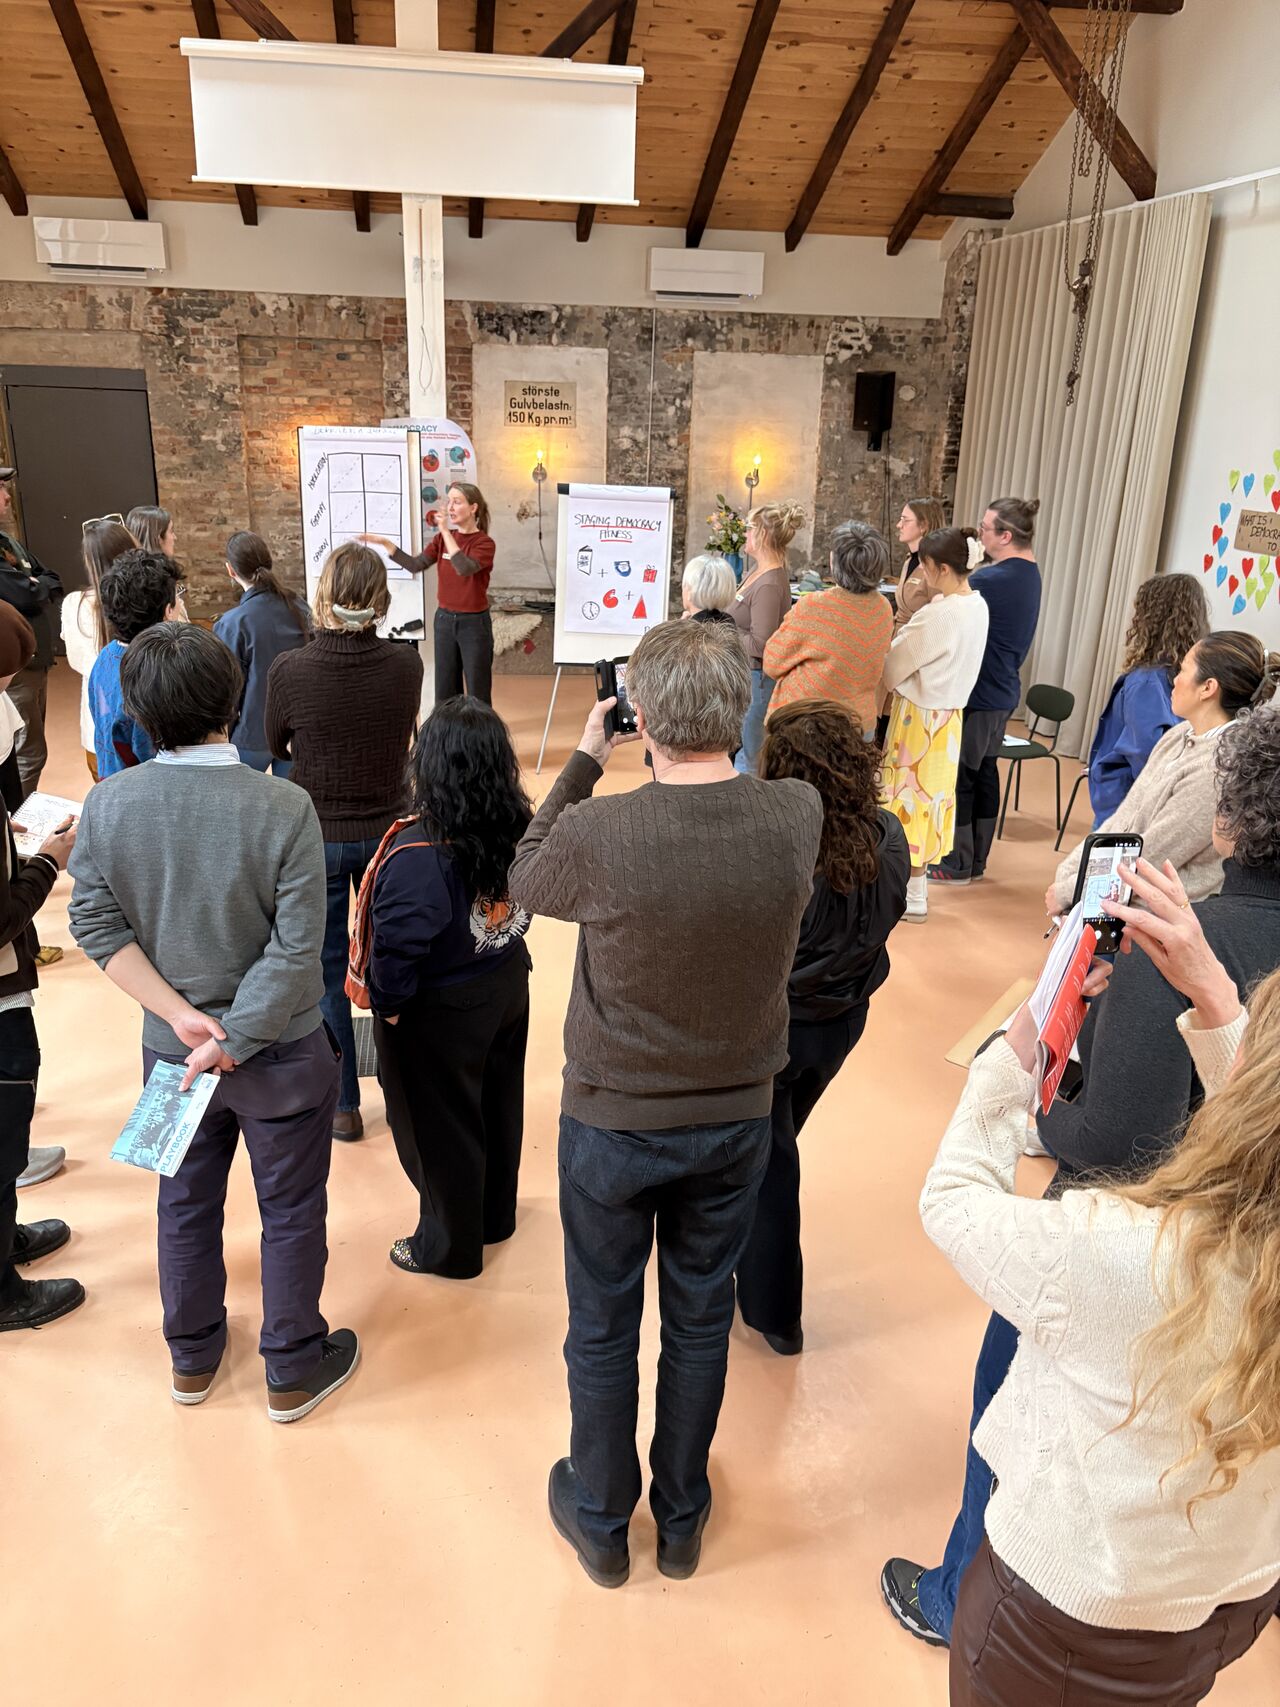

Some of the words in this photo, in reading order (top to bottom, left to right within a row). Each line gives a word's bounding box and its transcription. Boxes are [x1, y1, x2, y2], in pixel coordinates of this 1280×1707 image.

[522, 385, 560, 397] störste
[508, 411, 526, 423] 150
[574, 513, 611, 527] STAGING
[616, 516, 662, 532] DEMOCRACY
[1257, 515, 1268, 525] IS
[600, 529, 633, 540] FITNESS
[160, 1122, 191, 1173] PLAYBOOK
